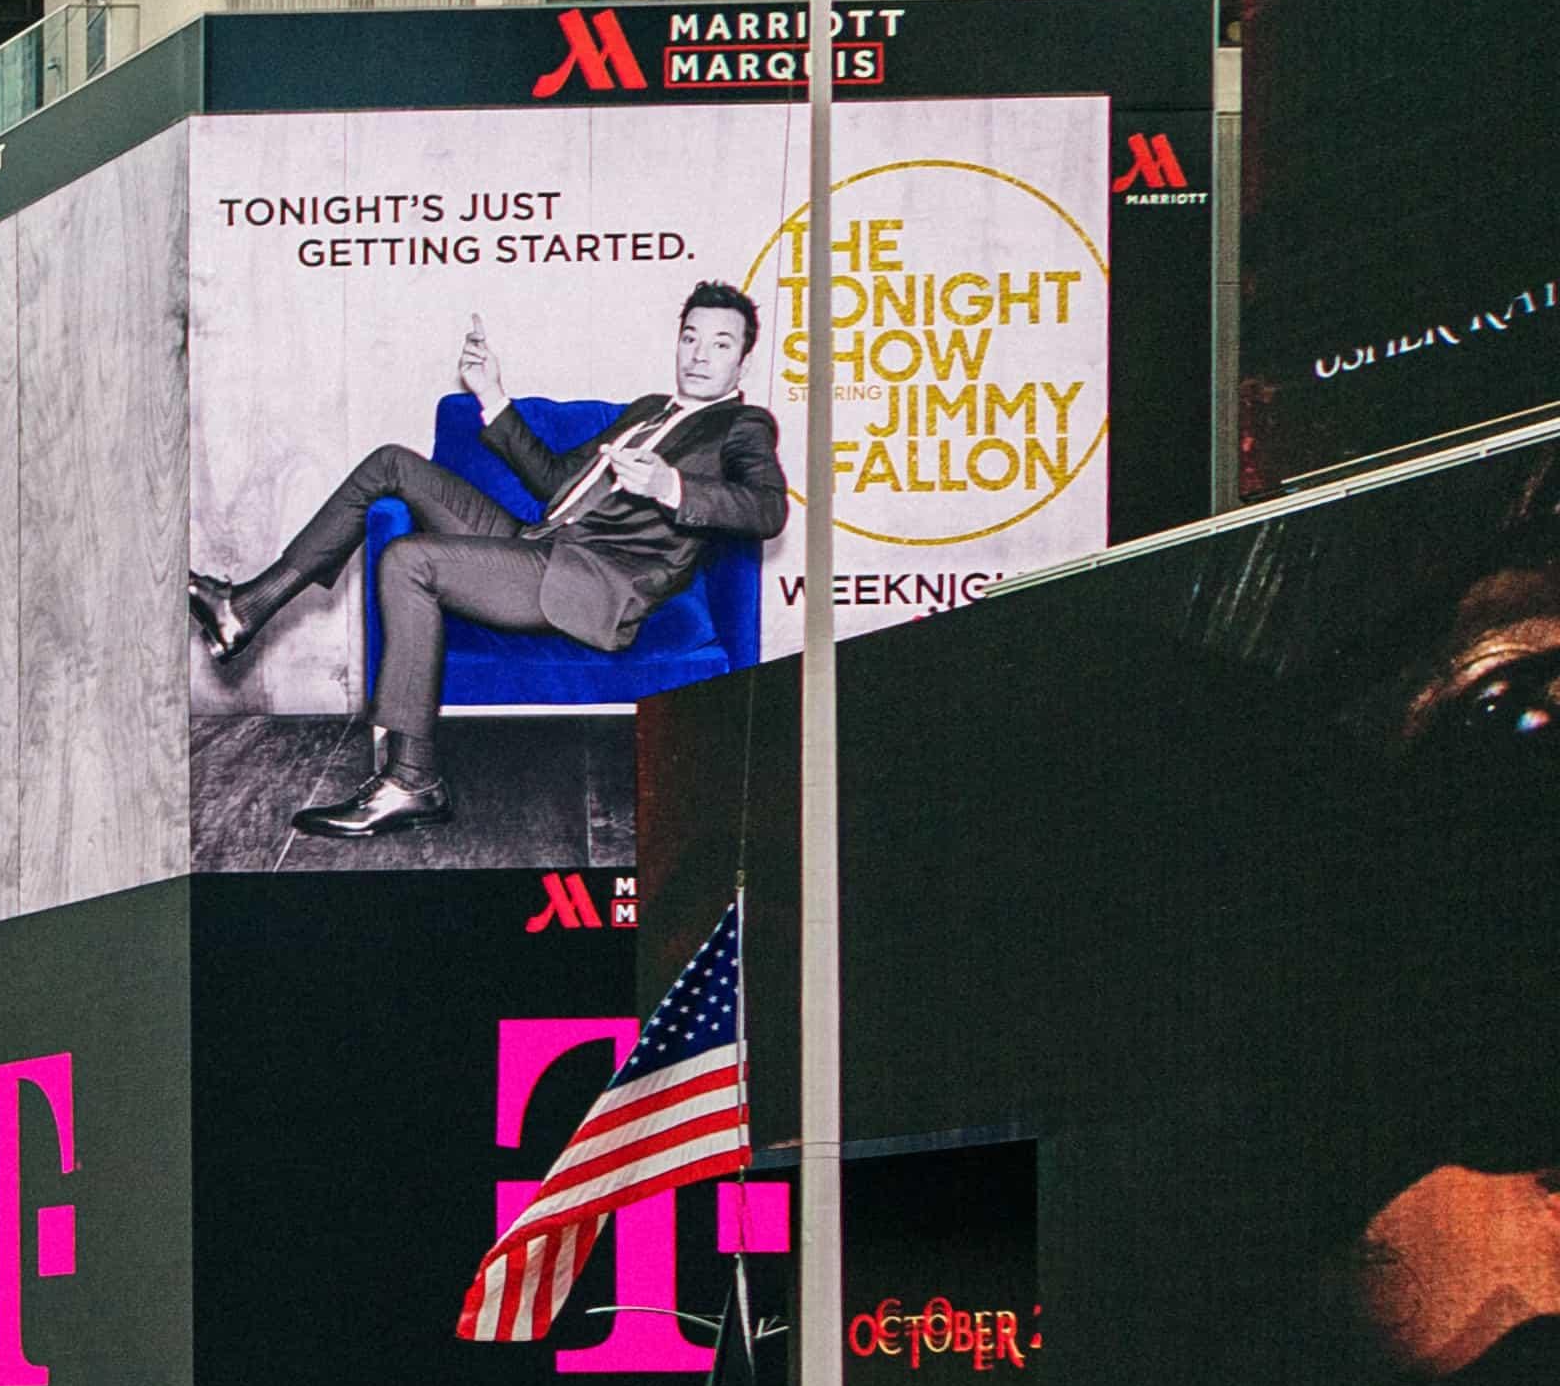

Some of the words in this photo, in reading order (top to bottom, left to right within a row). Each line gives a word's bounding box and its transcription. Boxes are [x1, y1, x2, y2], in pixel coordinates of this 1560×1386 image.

[220, 193, 446, 227] TONIGHT'S
[459, 192, 562, 223] JUST
[1126, 192, 1208, 205] MARRIOTT
[298, 234, 482, 268] GETTING
[496, 232, 695, 264] STARTED.
[779, 219, 904, 274] THE
[777, 271, 1082, 328] TONIGHT
[781, 329, 993, 386] SHOW
[865, 381, 1085, 440] JIMMY
[828, 438, 1071, 495] FALLON
